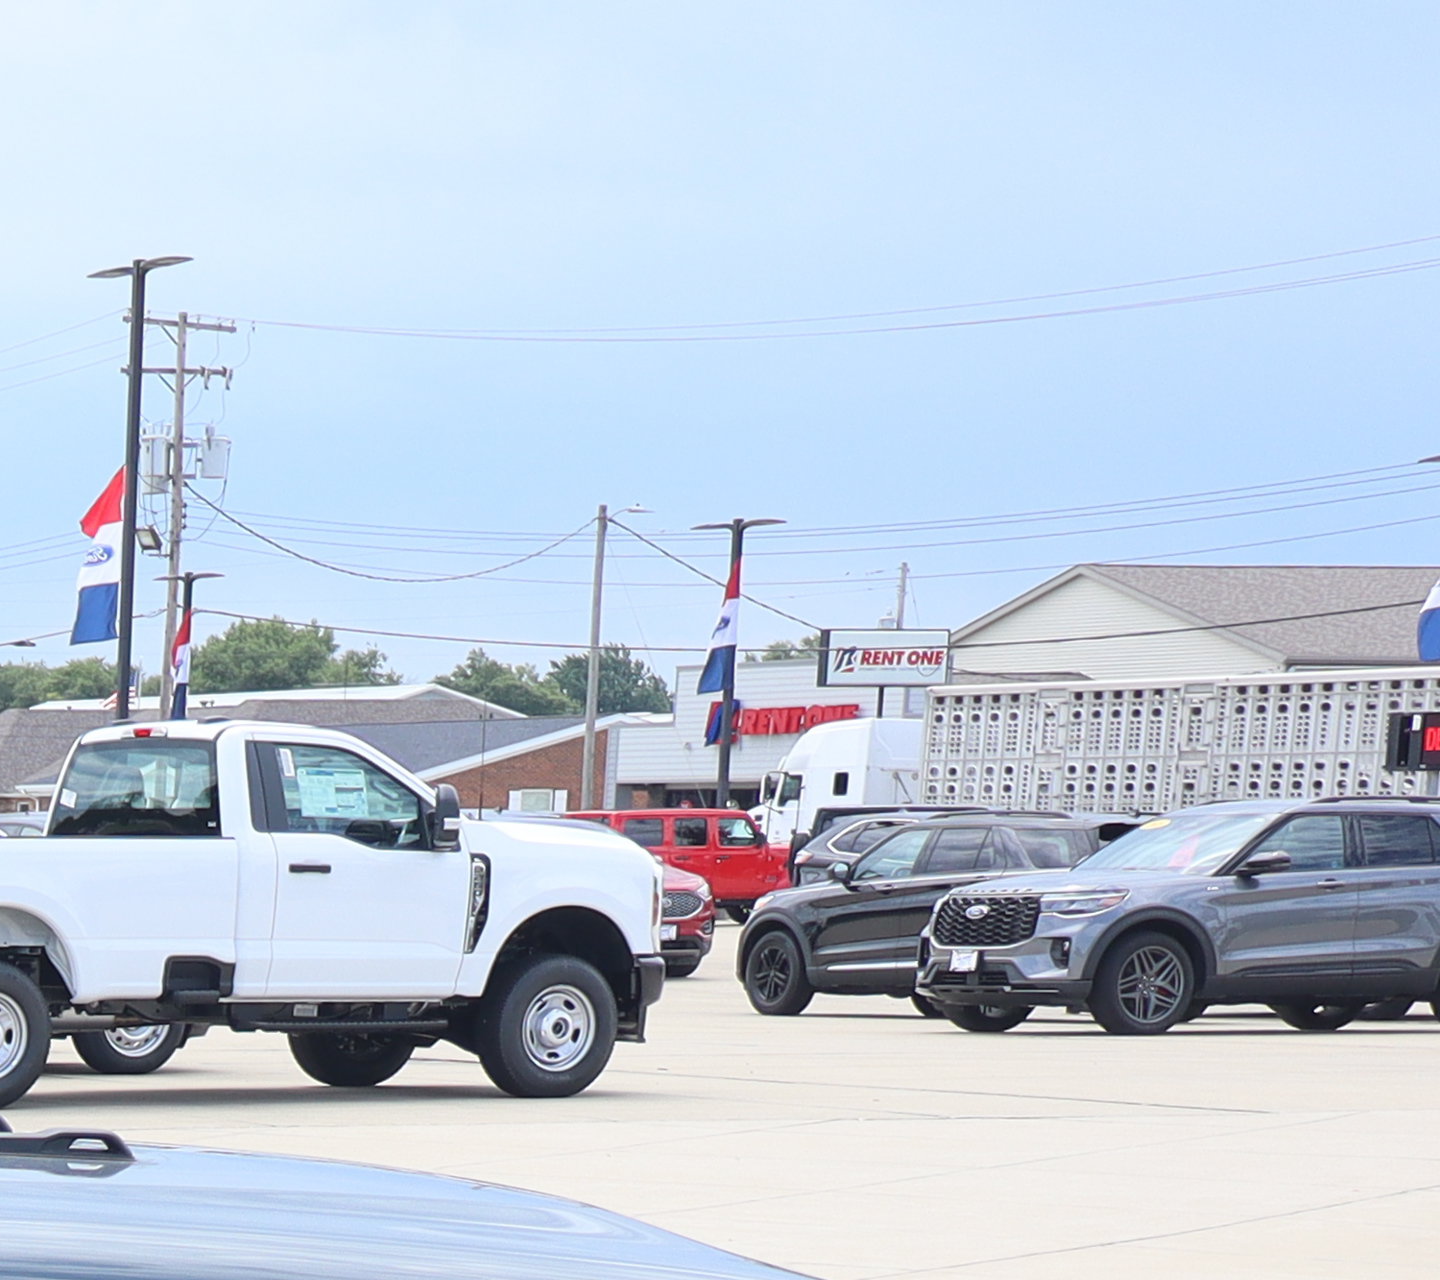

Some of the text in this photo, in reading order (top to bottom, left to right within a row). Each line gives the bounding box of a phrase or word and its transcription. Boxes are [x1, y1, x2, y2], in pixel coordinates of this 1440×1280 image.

[860, 650, 944, 666] RENT ONE
[741, 707, 806, 735] RENT
